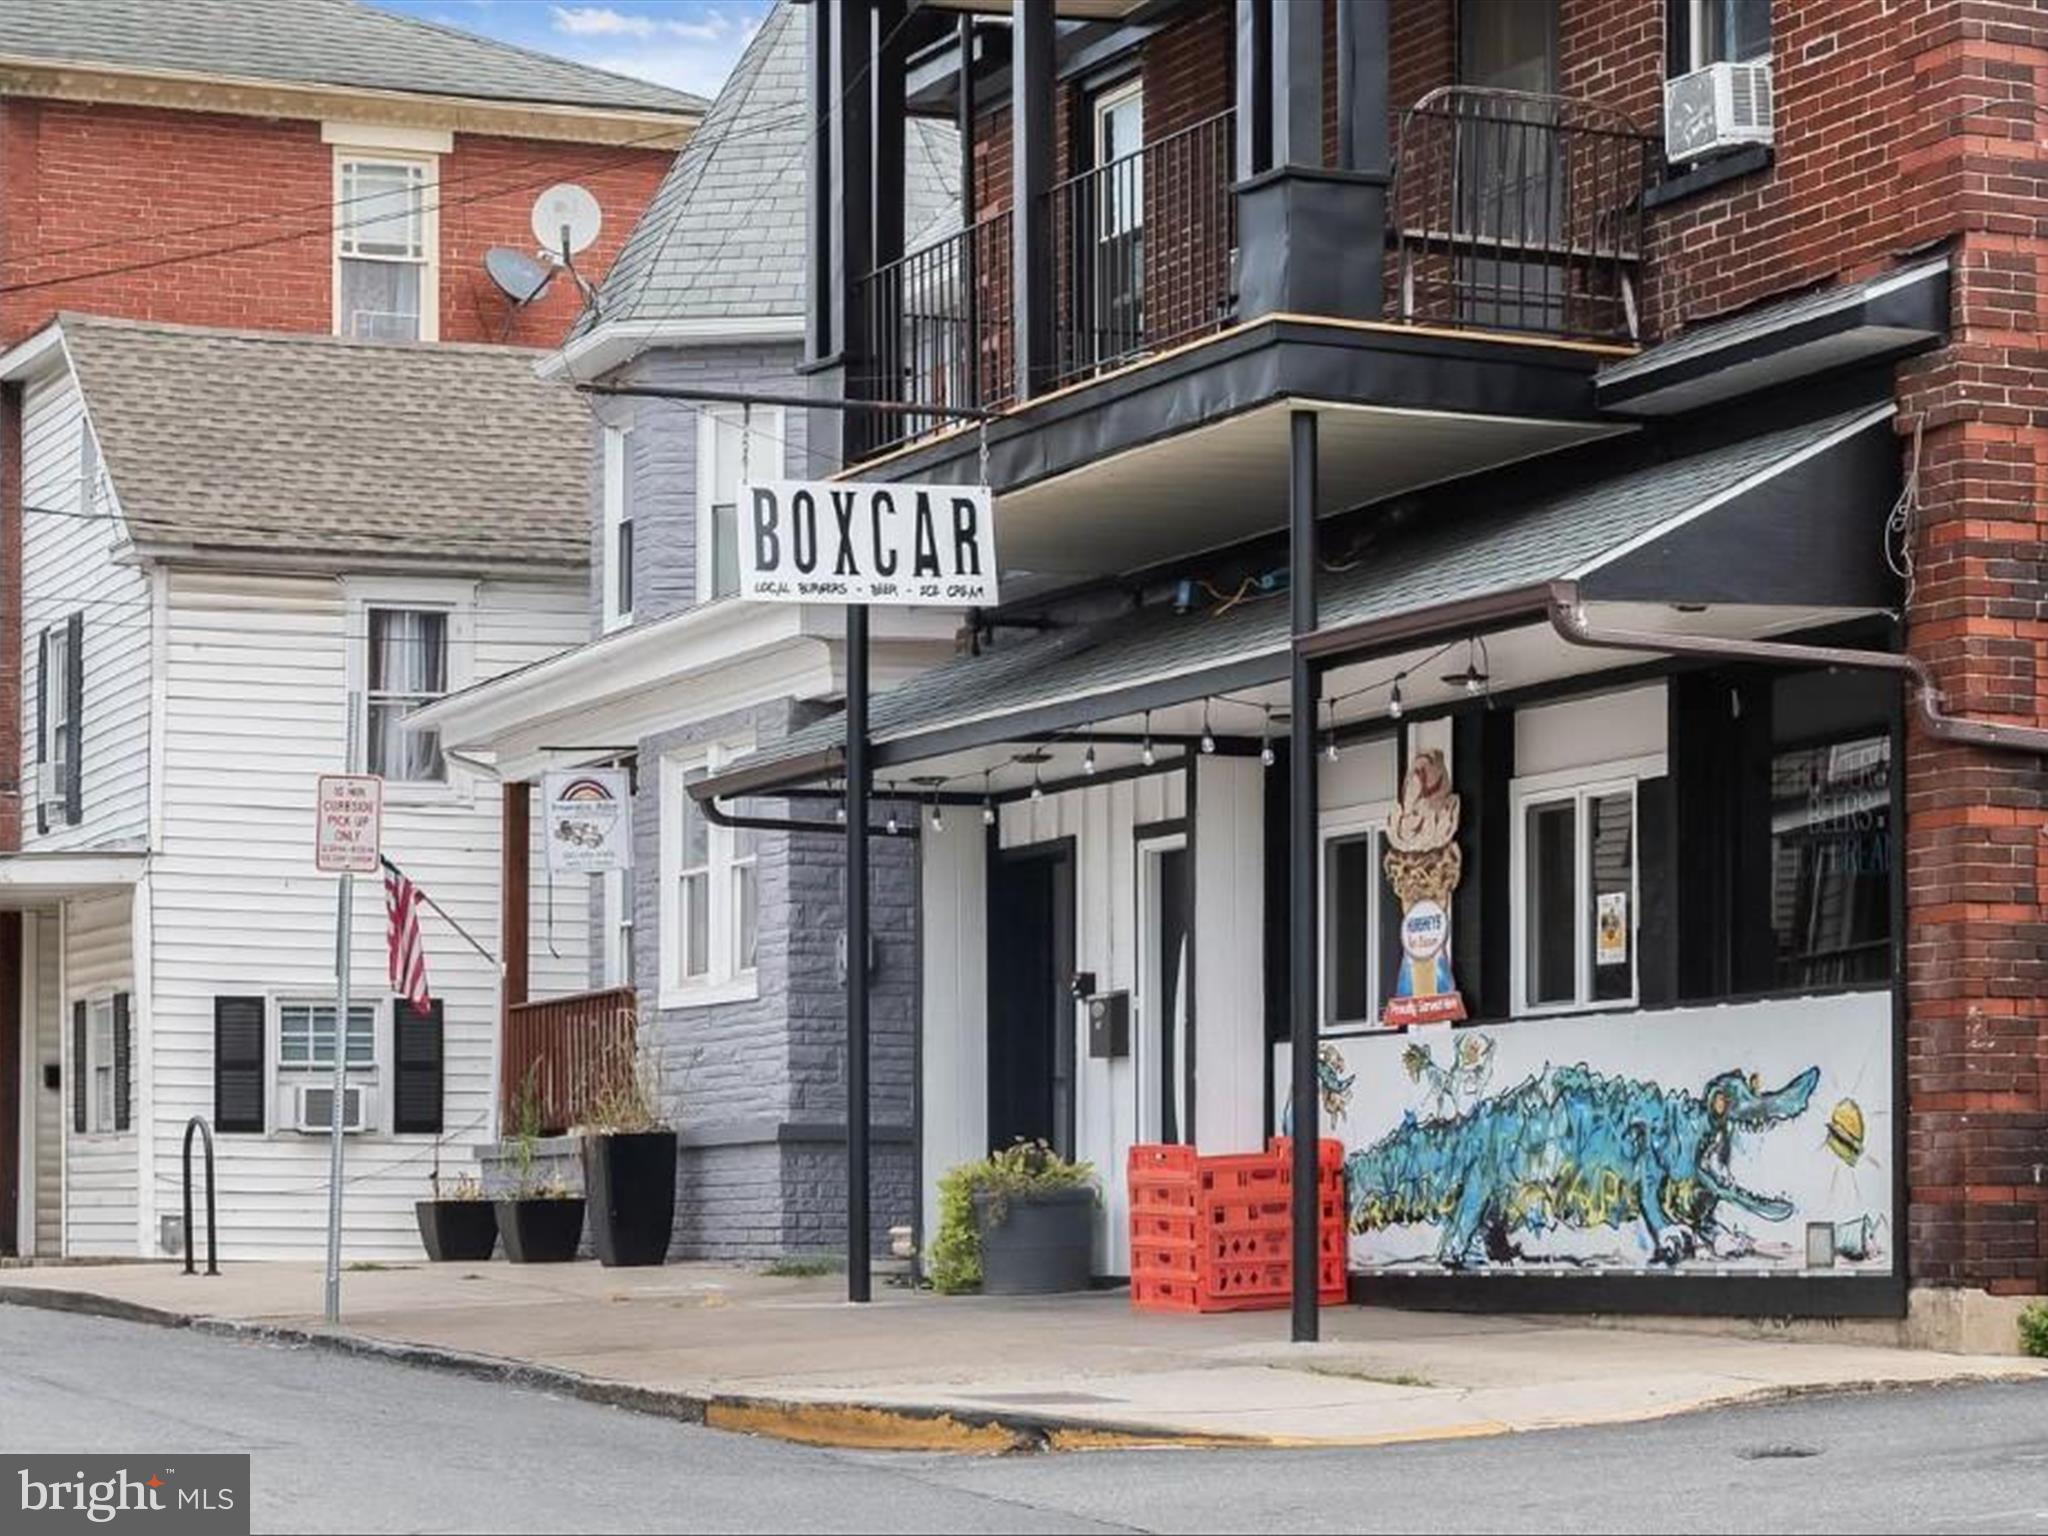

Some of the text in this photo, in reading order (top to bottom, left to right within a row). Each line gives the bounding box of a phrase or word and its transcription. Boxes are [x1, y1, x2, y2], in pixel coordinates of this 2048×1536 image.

[751, 487, 982, 577] BOXCAR
[754, 581, 791, 596] LOCAL
[797, 581, 848, 595] BURGERS
[869, 583, 899, 597] BEER
[919, 584, 941, 597] ICE
[946, 584, 984, 599] CREAM
[323, 800, 374, 814] CURBSIDE
[327, 814, 369, 828] PICK UP
[334, 828, 362, 842] ONLY
